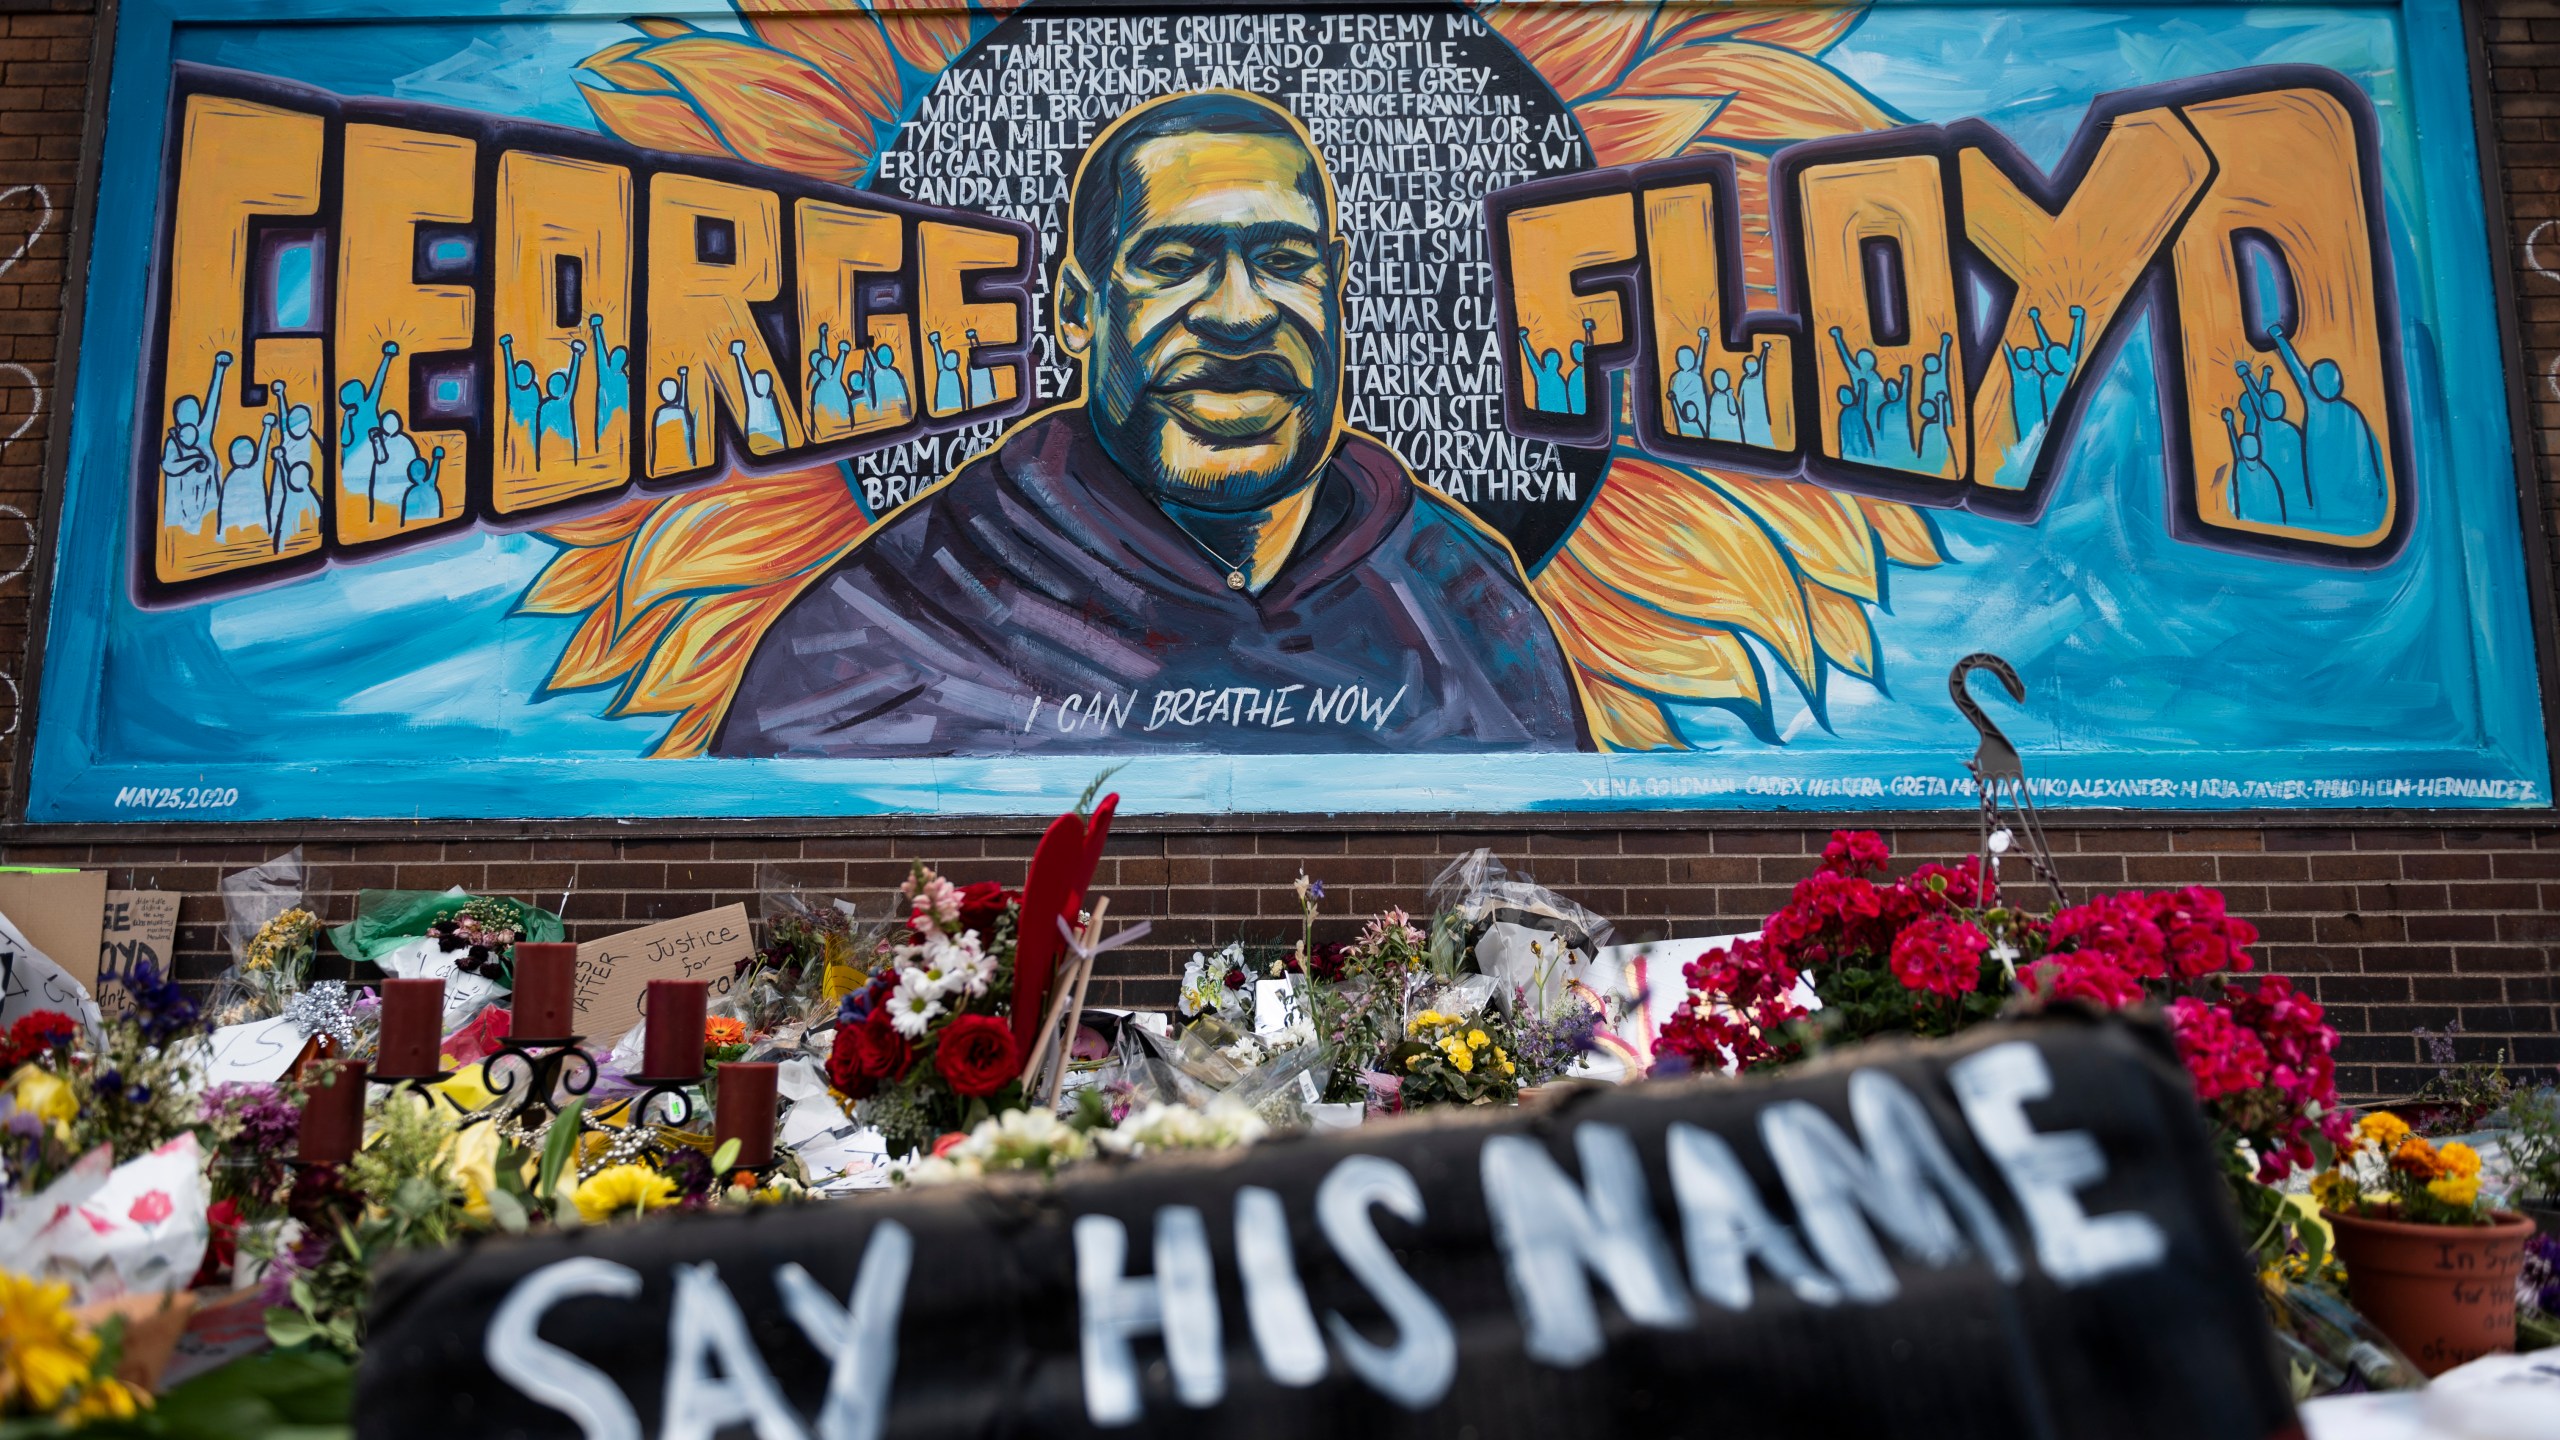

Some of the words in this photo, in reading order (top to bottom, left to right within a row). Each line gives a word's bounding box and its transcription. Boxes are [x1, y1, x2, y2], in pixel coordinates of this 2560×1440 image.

[1022, 17, 1170, 45] TERRENCE
[986, 44, 1077, 70] TAMIR
[1078, 45, 1148, 70] RICE
[1174, 42, 1324, 68] PHILANDO
[1350, 42, 1458, 68] CASTILE
[934, 68, 993, 96] AKAI
[1191, 65, 1281, 93] JAMES
[1301, 69, 1412, 94] FREDDIE
[1419, 66, 1491, 94] GREY
[923, 94, 1041, 123] MICHAEL
[1284, 92, 1398, 118] TERRANCE
[1402, 93, 1521, 117] FRANKLIN
[901, 121, 997, 153] TYISHA
[1310, 117, 1434, 146] BREONNA
[1431, 116, 1531, 144] TAYLOR
[880, 150, 942, 178] ERIC
[945, 149, 1067, 178] GARNER
[1325, 144, 1447, 174] SHANTEL
[1450, 143, 1528, 173] DAVIS
[899, 176, 1014, 206] SANDRA
[1331, 172, 1447, 202] WALTER
[1337, 200, 1420, 232] REKIA
[1346, 261, 1447, 296] SHELLY
[1342, 296, 1447, 333] JAMAR
[152, 90, 1028, 586] GEORGE
[1500, 84, 2402, 552] FLOYD
[1345, 332, 1473, 366] TANISHA
[1345, 364, 1451, 396] TARIKA
[1347, 394, 1441, 432] ALTON
[1385, 430, 1564, 472] KORRYNGA
[1428, 468, 1577, 502] KATHRYN
[1023, 695, 1042, 733] I
[1057, 688, 1138, 735] CAN
[1143, 682, 1305, 733] BREATHE
[1306, 682, 1410, 732] NOW
[1581, 777, 1642, 797] XENA
[1890, 776, 1948, 797] GRETA
[646, 927, 739, 962] Justice
[681, 956, 711, 978] for
[484, 1218, 916, 1440] SAY
[1073, 1153, 1459, 1428] HIS
[1479, 1040, 2168, 1369] NAME
